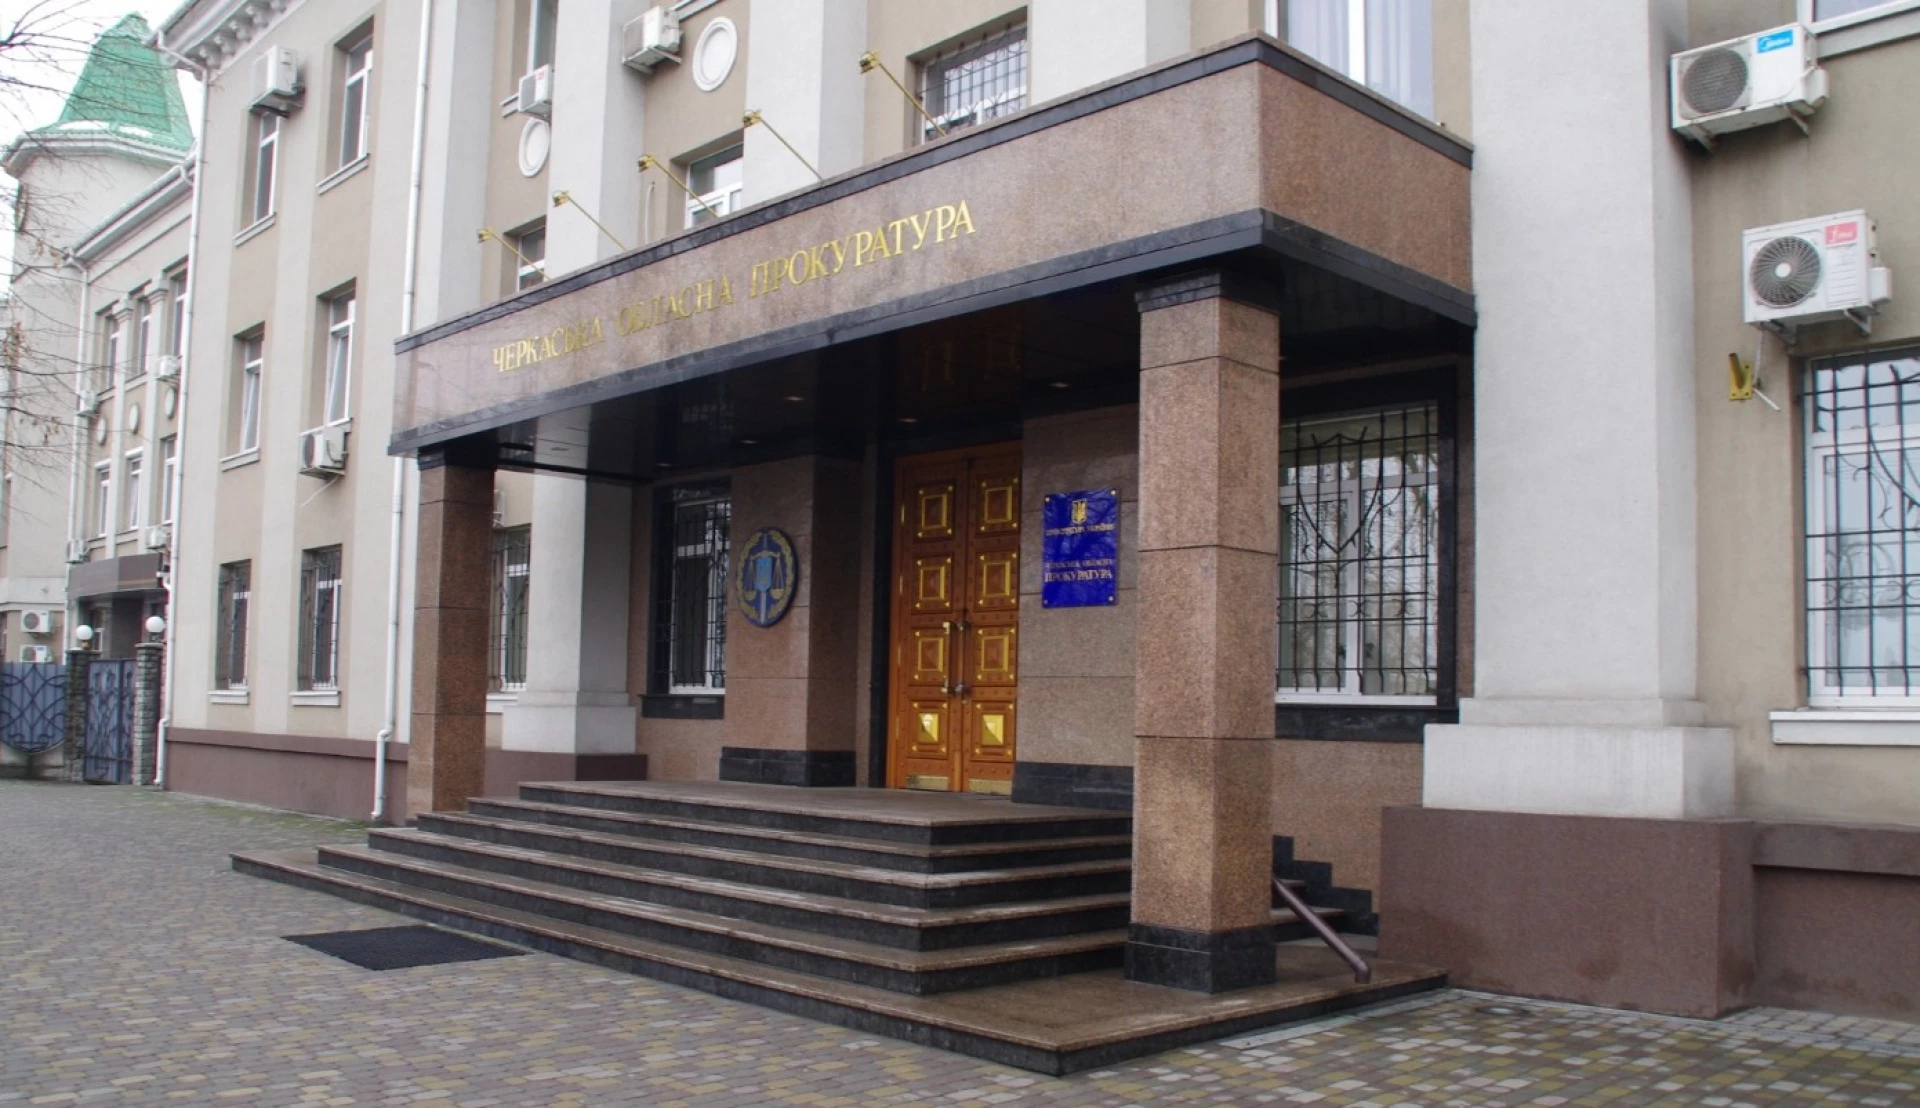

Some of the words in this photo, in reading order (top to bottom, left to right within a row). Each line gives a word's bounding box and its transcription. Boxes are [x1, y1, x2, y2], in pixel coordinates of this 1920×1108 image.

[493, 315, 604, 372] ЧЕРКАСЬКА
[616, 275, 734, 337] ОБЛАСНА
[750, 200, 976, 298] ПРОКУРАТУРА
